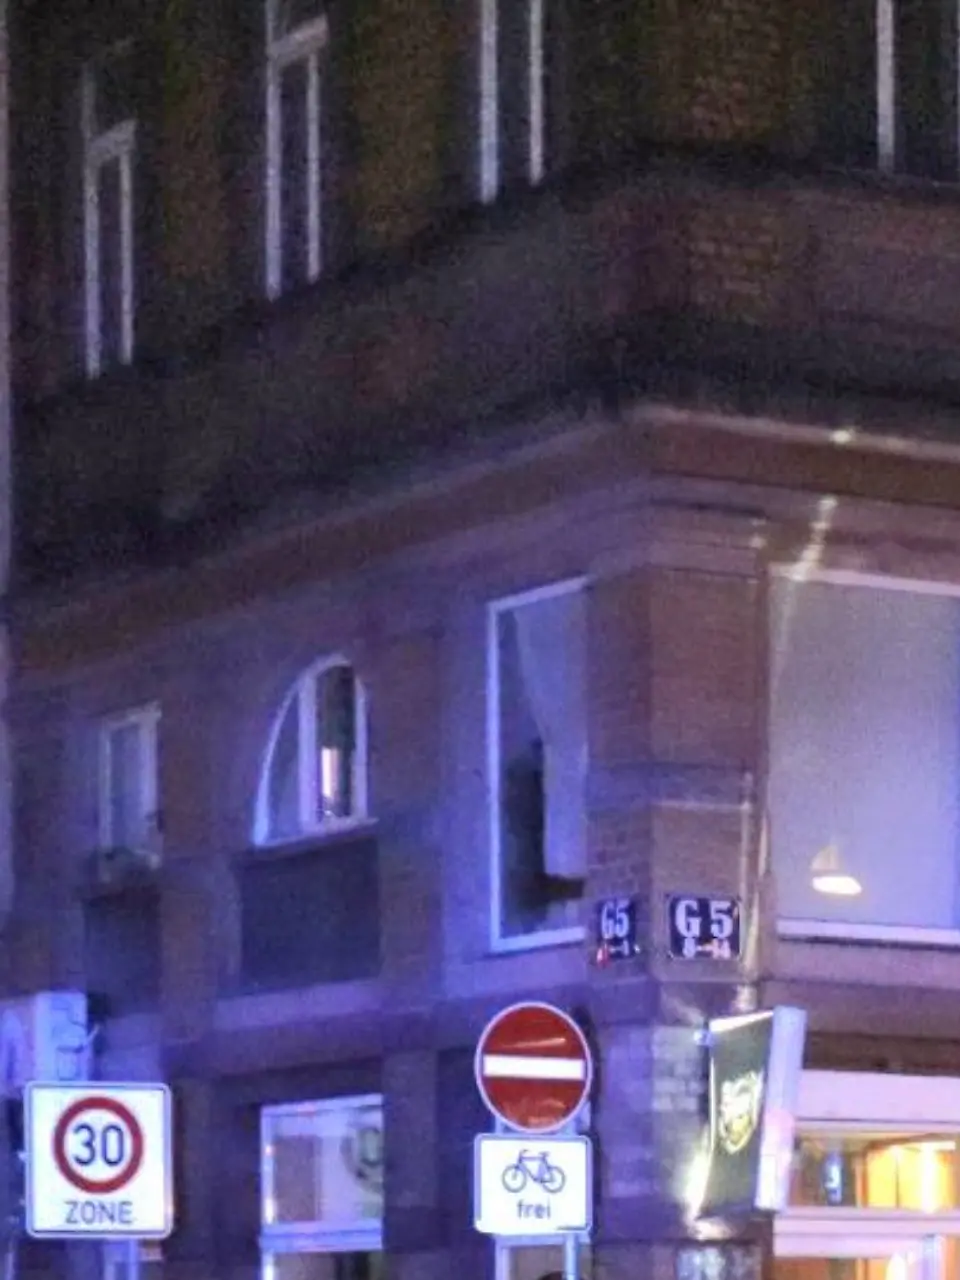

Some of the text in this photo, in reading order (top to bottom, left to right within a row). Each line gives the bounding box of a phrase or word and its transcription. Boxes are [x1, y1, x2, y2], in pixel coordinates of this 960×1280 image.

[73, 1122, 126, 1168] 30
[63, 1200, 135, 1226] ZONE
[517, 1199, 552, 1219] frei
